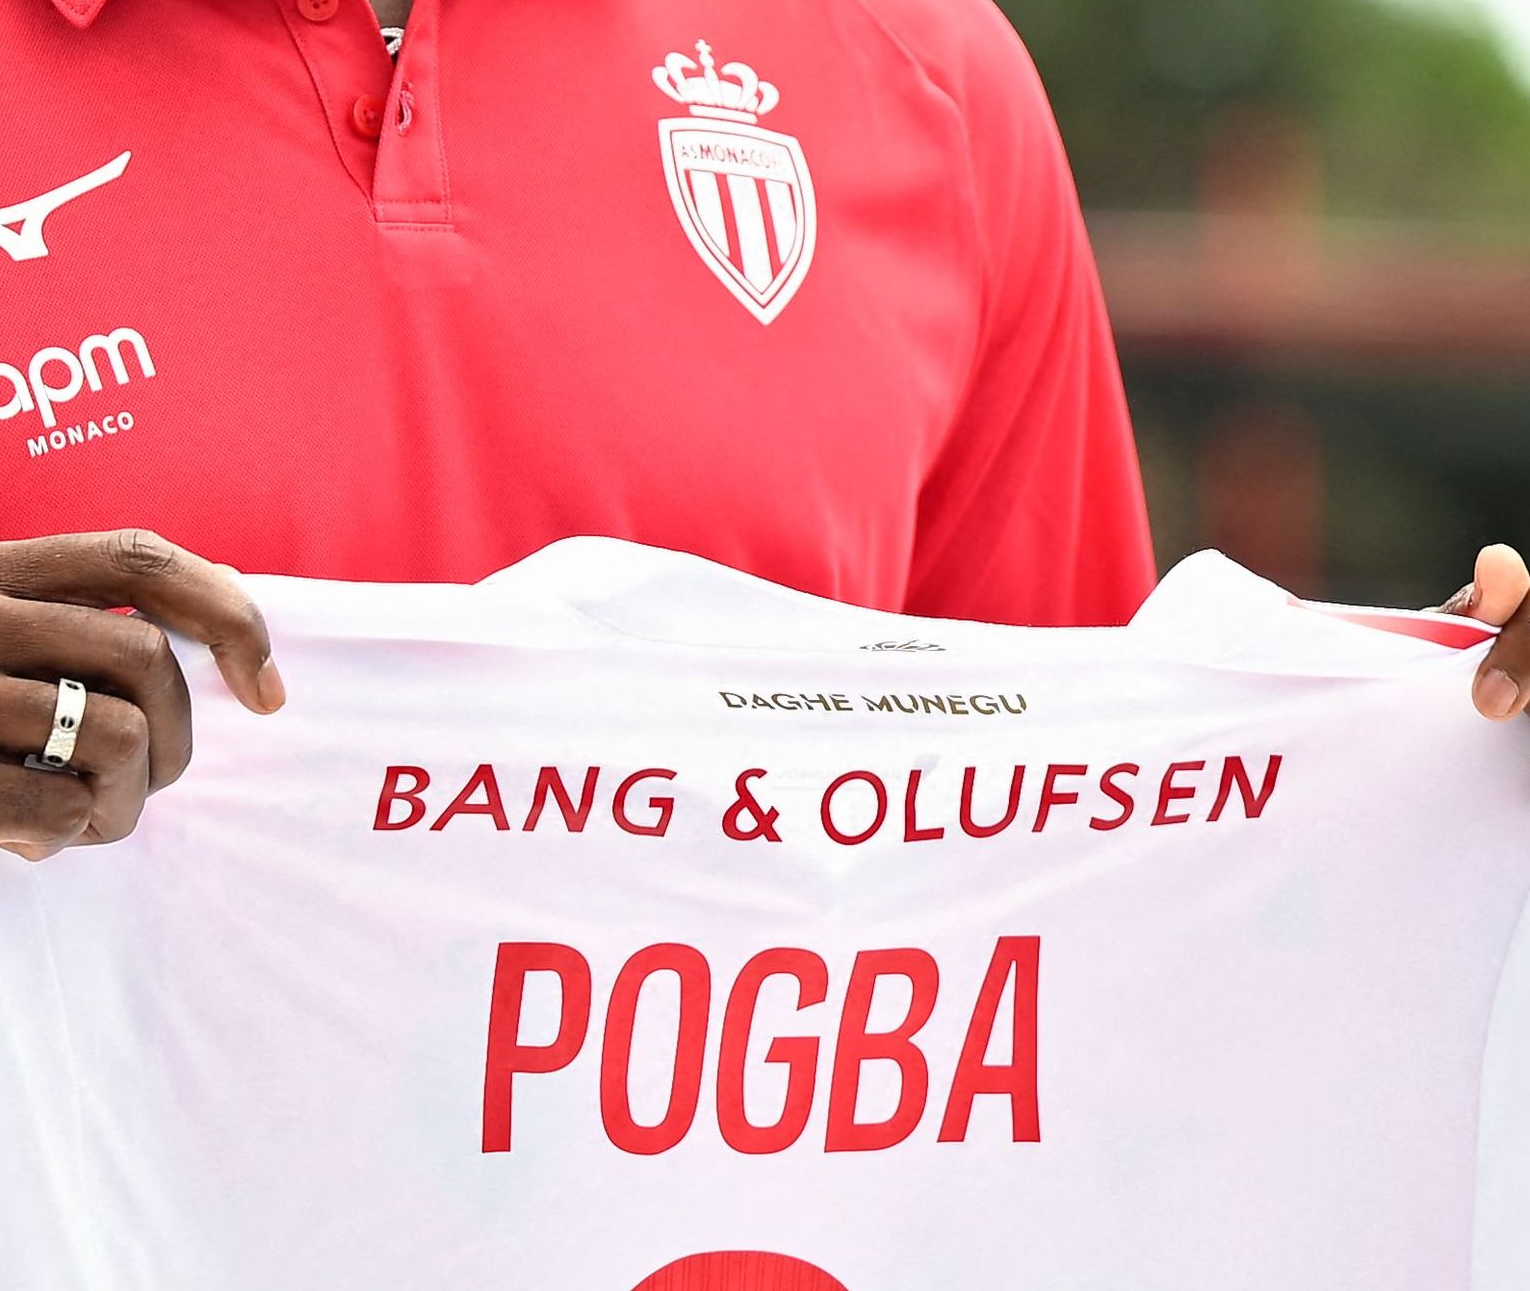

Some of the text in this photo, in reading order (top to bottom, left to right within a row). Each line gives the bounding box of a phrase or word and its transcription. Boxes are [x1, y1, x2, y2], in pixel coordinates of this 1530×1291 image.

[27, 411, 134, 458] MONACO
[719, 692, 1026, 715] DAGHE MUNEGU
[373, 755, 1282, 845] BANG & OLUFSEN
[482, 935, 1041, 1156] POGBA
